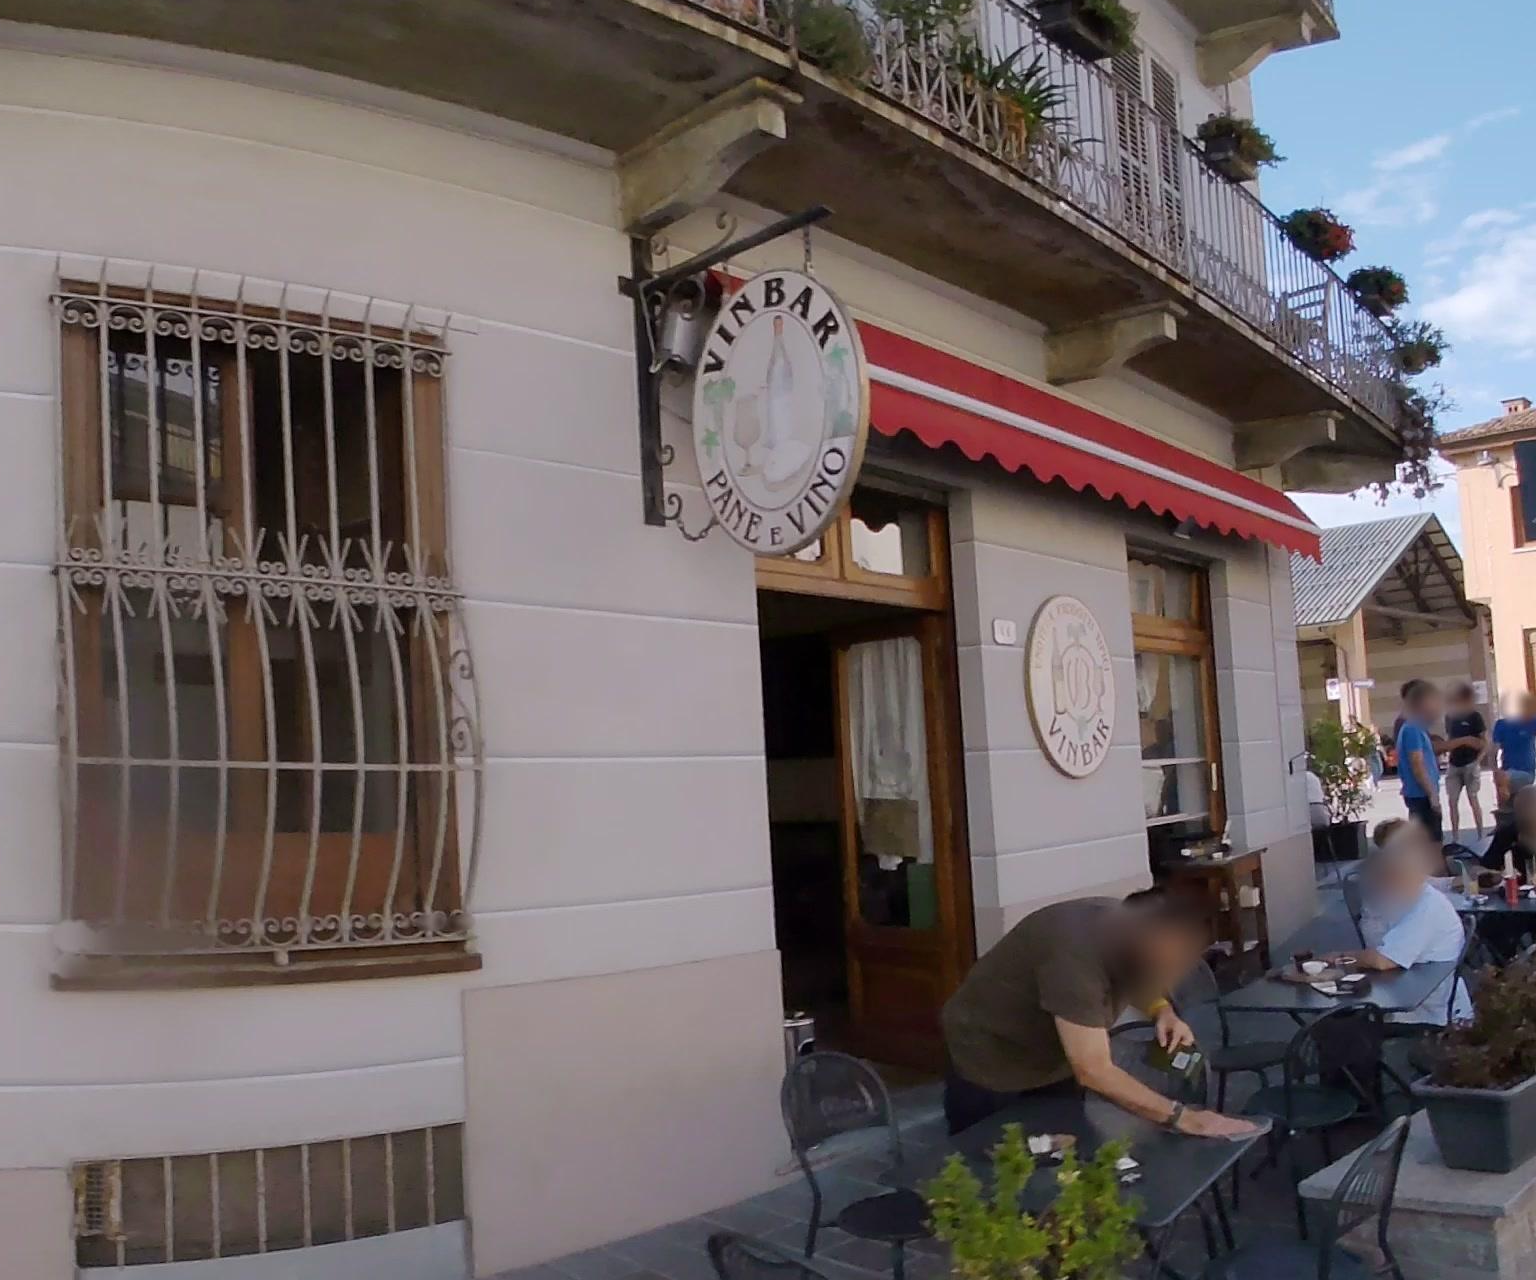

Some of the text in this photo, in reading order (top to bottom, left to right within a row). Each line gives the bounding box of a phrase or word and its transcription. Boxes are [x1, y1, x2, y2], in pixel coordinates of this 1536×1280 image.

[703, 277, 840, 375] VINBAR
[706, 447, 846, 546] PANE E VINO
[1049, 716, 1110, 767] VINBAR
